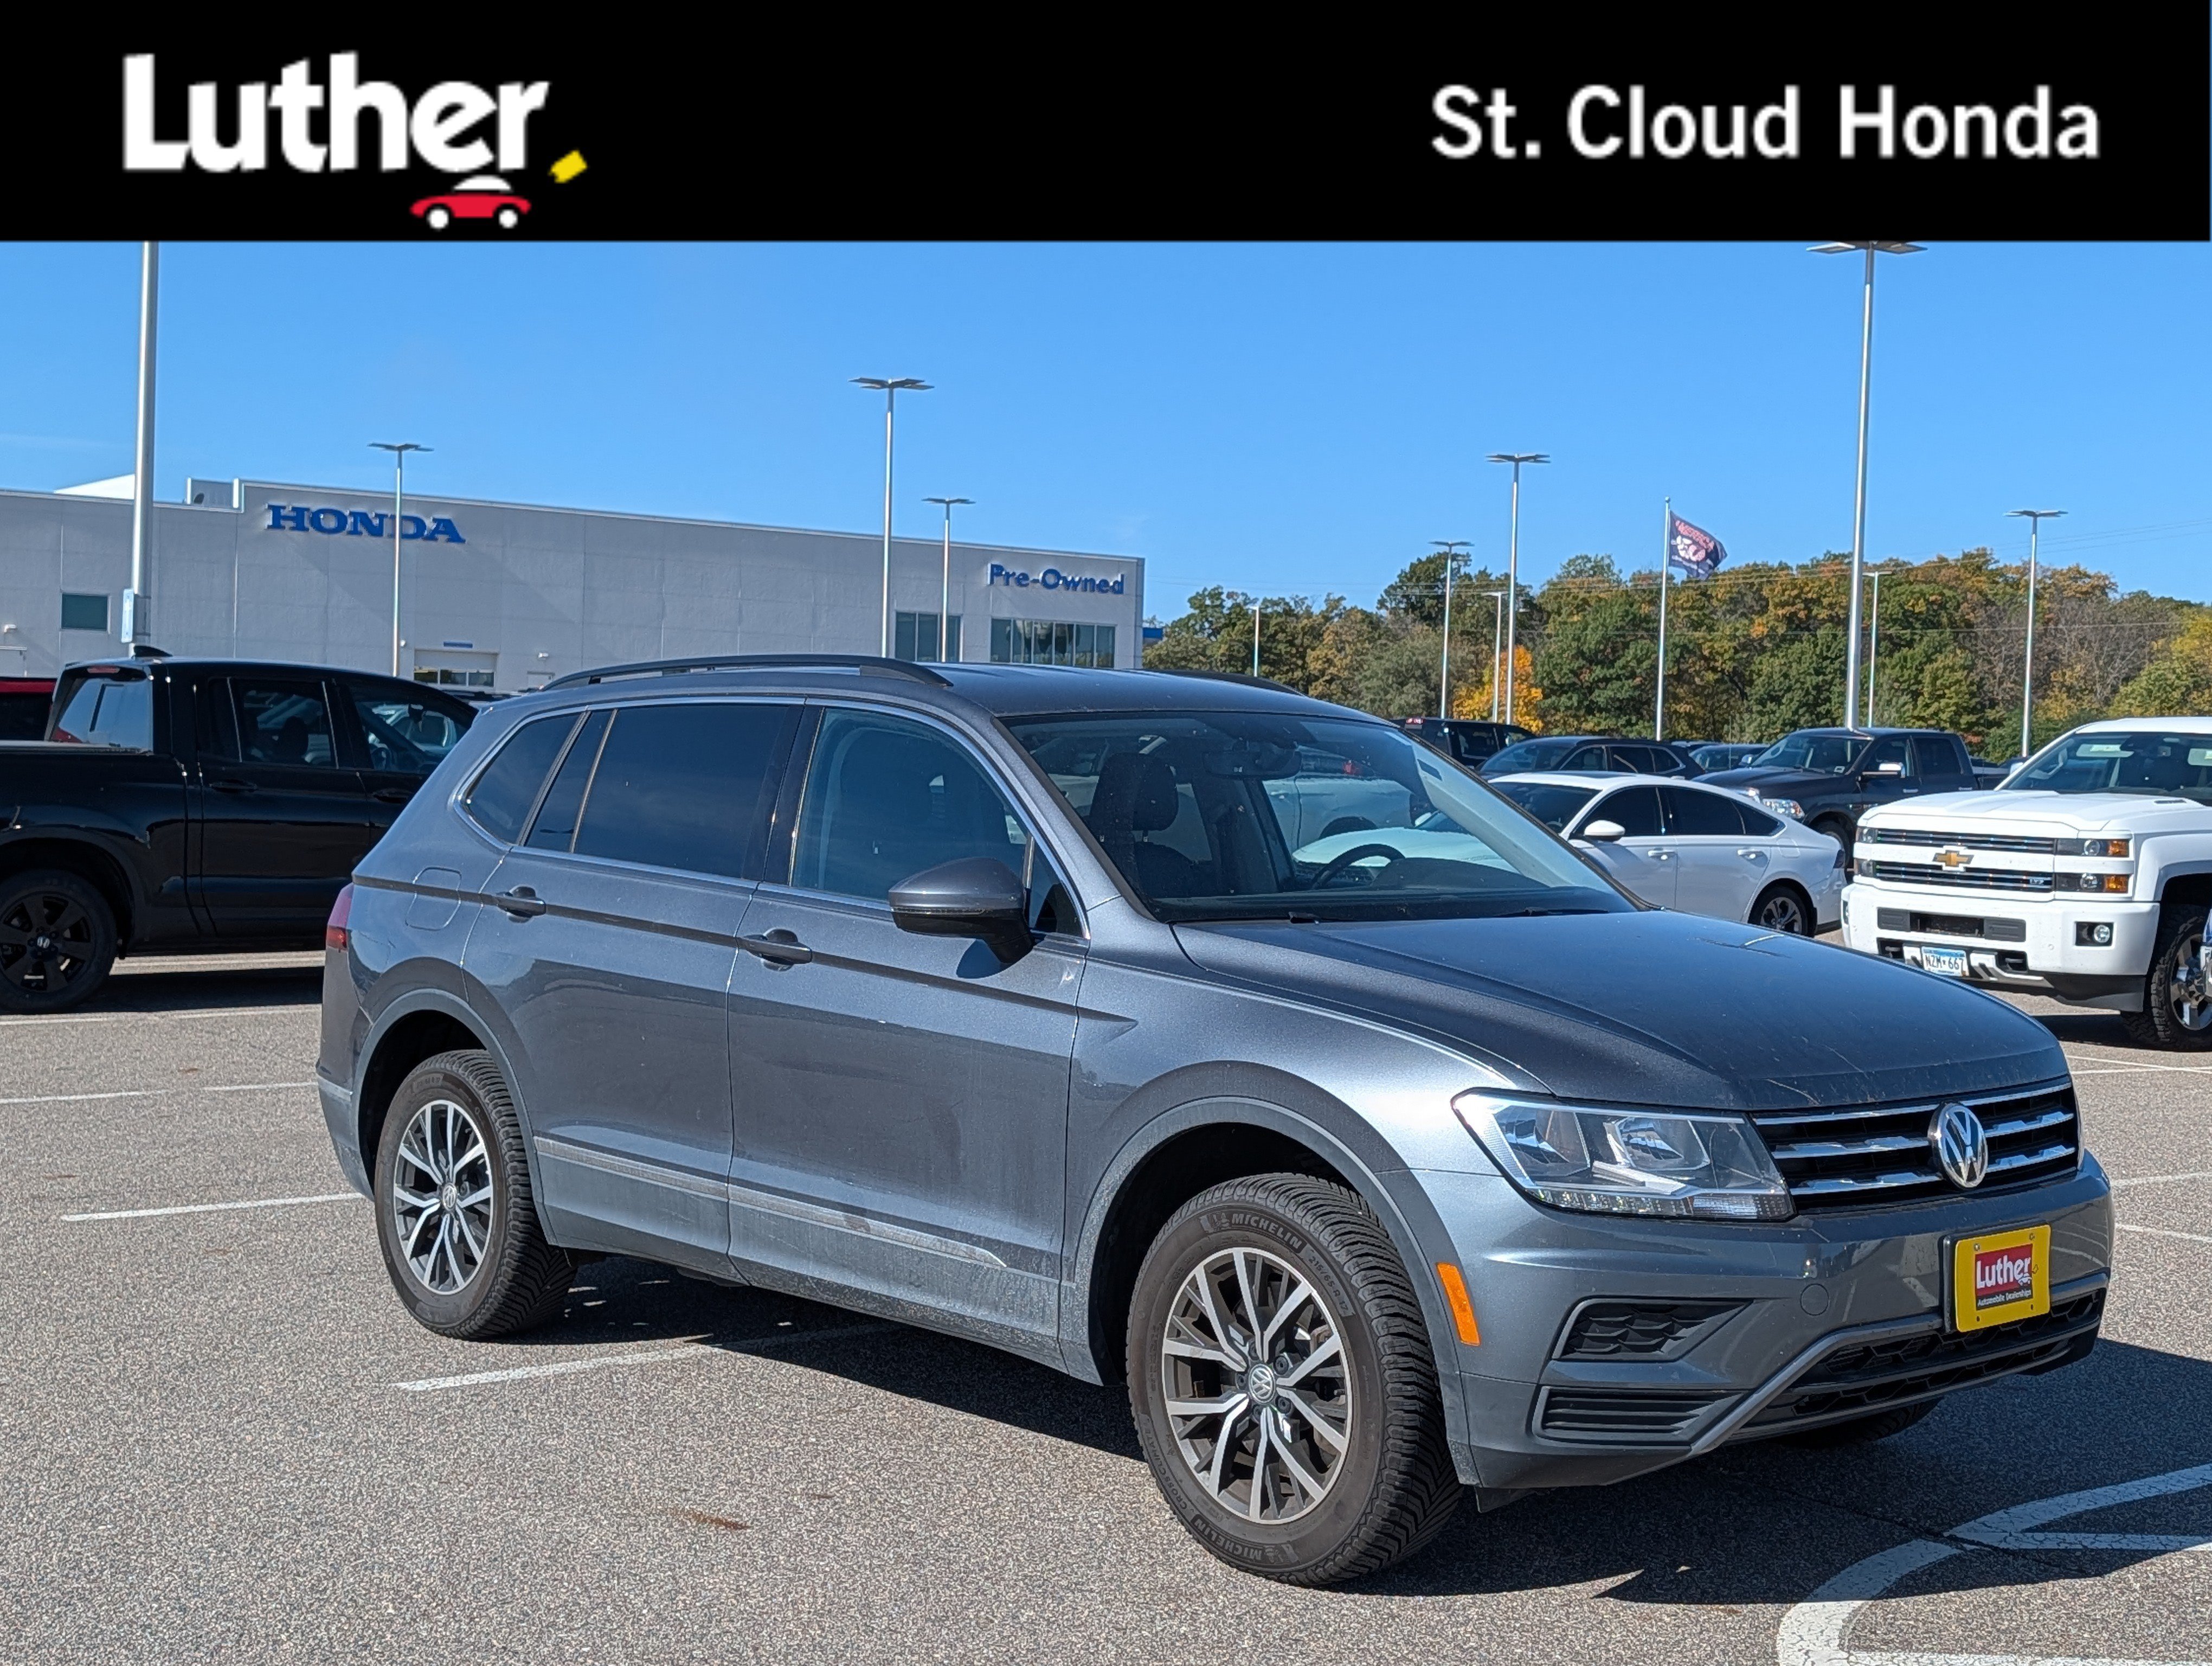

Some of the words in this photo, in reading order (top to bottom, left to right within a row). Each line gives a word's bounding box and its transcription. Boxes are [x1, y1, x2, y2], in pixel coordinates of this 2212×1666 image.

[265, 503, 466, 543] HONDA
[988, 563, 1124, 595] Pre-Owned
[1232, 1213, 1302, 1248] MICHELIN
[1976, 1254, 2031, 1289] Luther
[1194, 1518, 1262, 1561] MICHELIN
